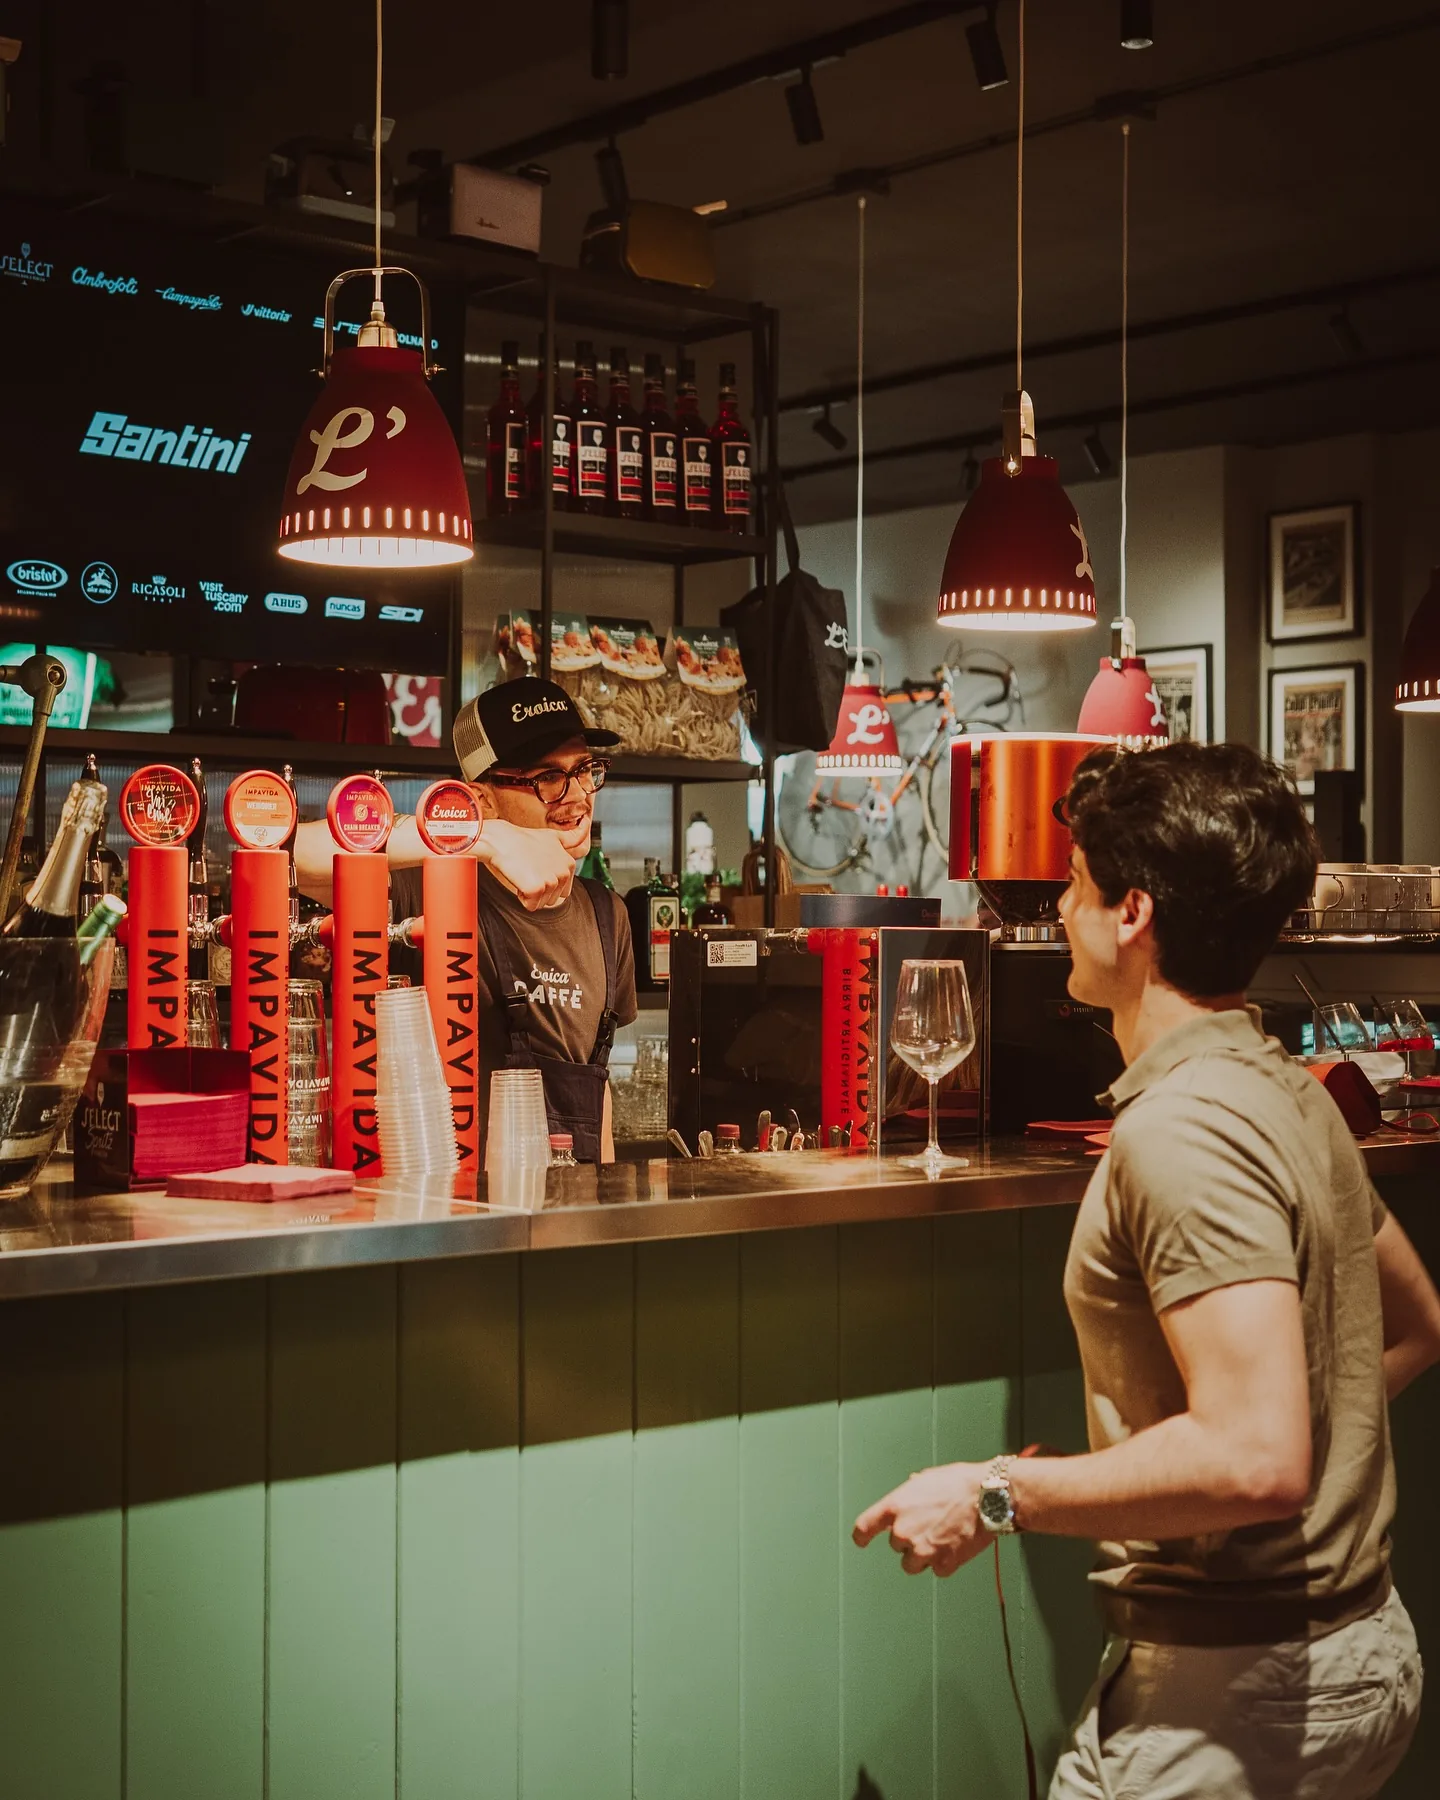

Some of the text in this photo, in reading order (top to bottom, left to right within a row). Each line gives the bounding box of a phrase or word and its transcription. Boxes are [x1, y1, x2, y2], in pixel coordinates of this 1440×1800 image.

[0, 256, 54, 278] SELECT
[253, 306, 292, 322] vittoria
[79, 411, 252, 474] Santini
[17, 566, 58, 583] bristot
[132, 582, 186, 599] RICASOLI
[271, 597, 302, 609] ABUS
[329, 602, 361, 613] nuncas
[511, 696, 568, 723] Eroica
[141, 784, 181, 792] IMPAVIDA
[245, 788, 279, 796] IMPAVIDA
[431, 804, 469, 819] Eroica
[287, 1076, 331, 1089] MPAVIDA
[81, 1107, 121, 1132] SELECT
